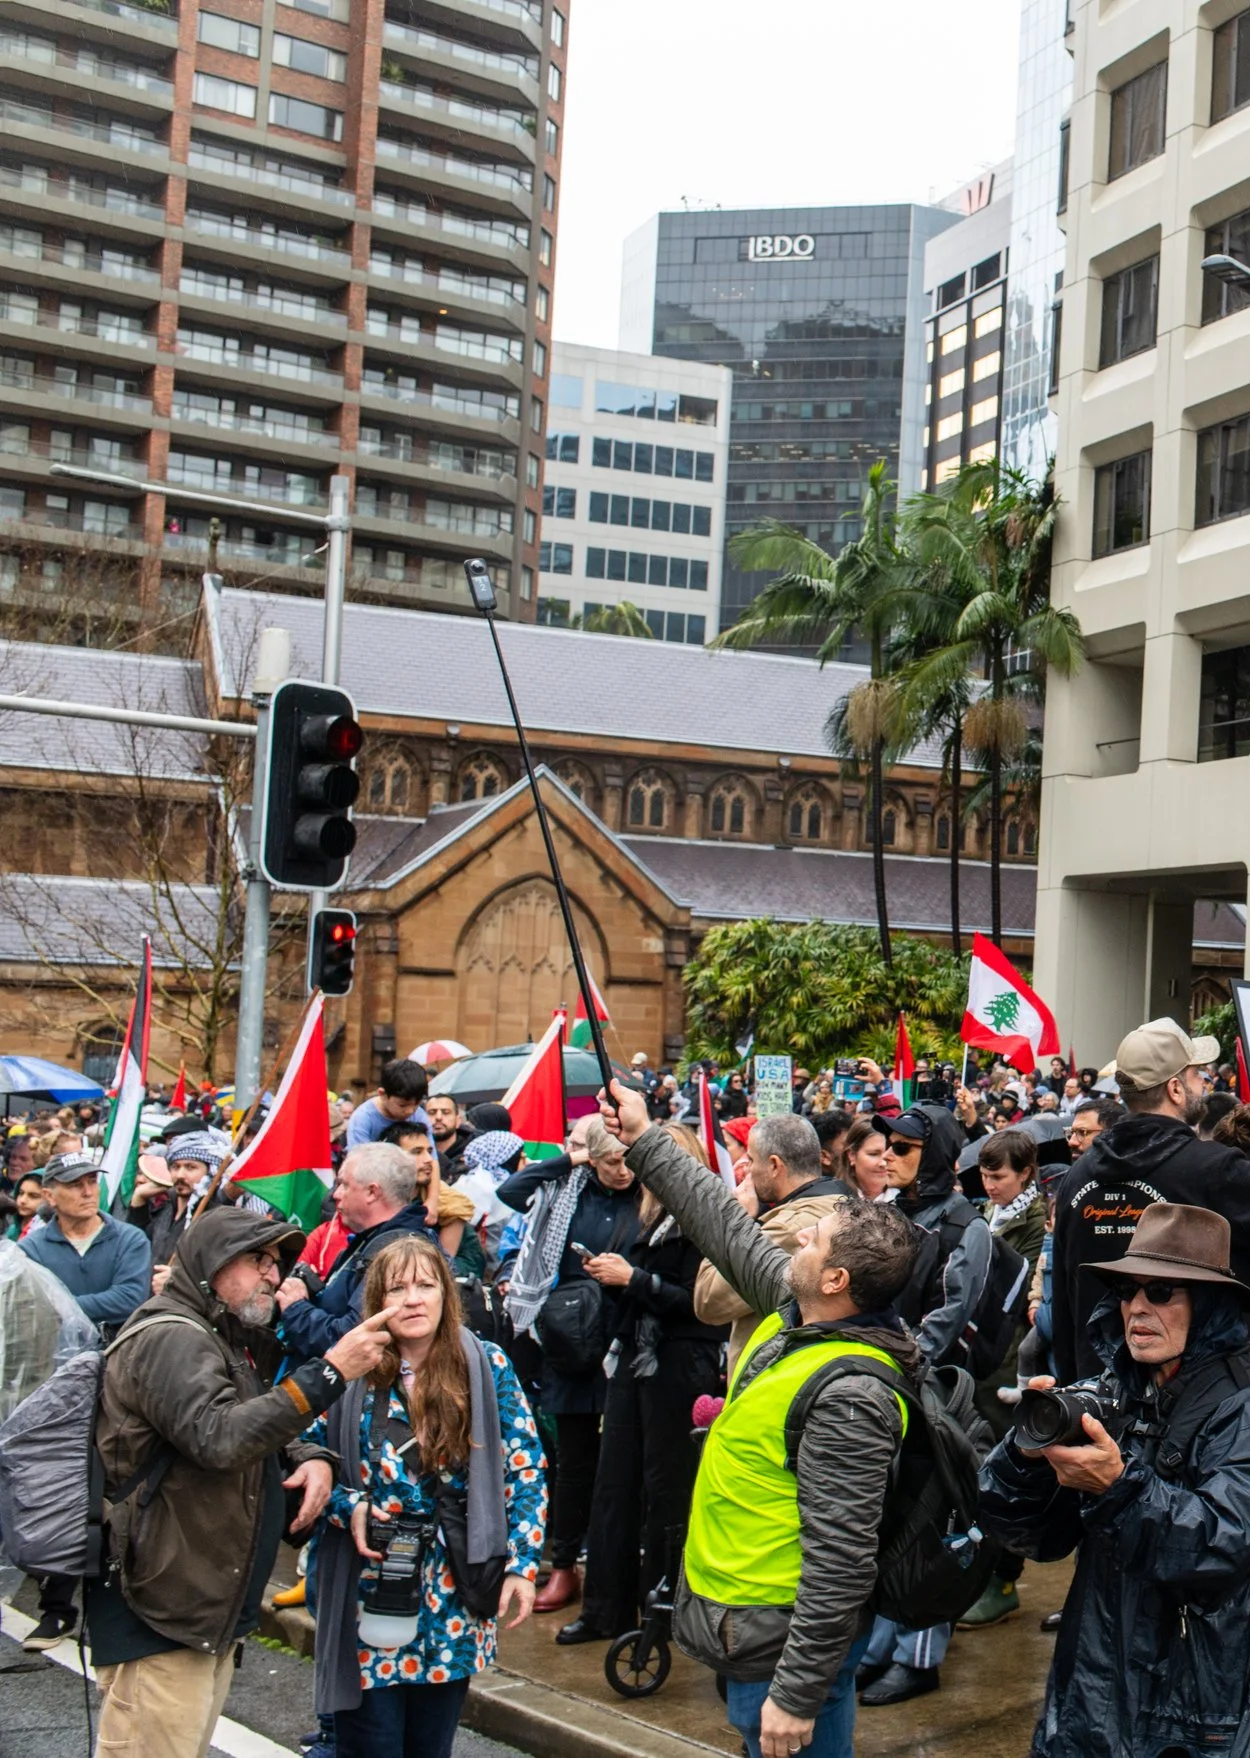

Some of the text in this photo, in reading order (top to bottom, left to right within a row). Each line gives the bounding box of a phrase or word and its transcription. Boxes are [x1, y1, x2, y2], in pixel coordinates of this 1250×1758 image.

[754, 234, 815, 259] BDO
[756, 1069, 789, 1080] USA
[1071, 1180, 1099, 1208] STATE
[1104, 1193, 1126, 1201] DIV 1
[1083, 1204, 1120, 1221] Original
[1094, 1226, 1115, 1234] EST.
